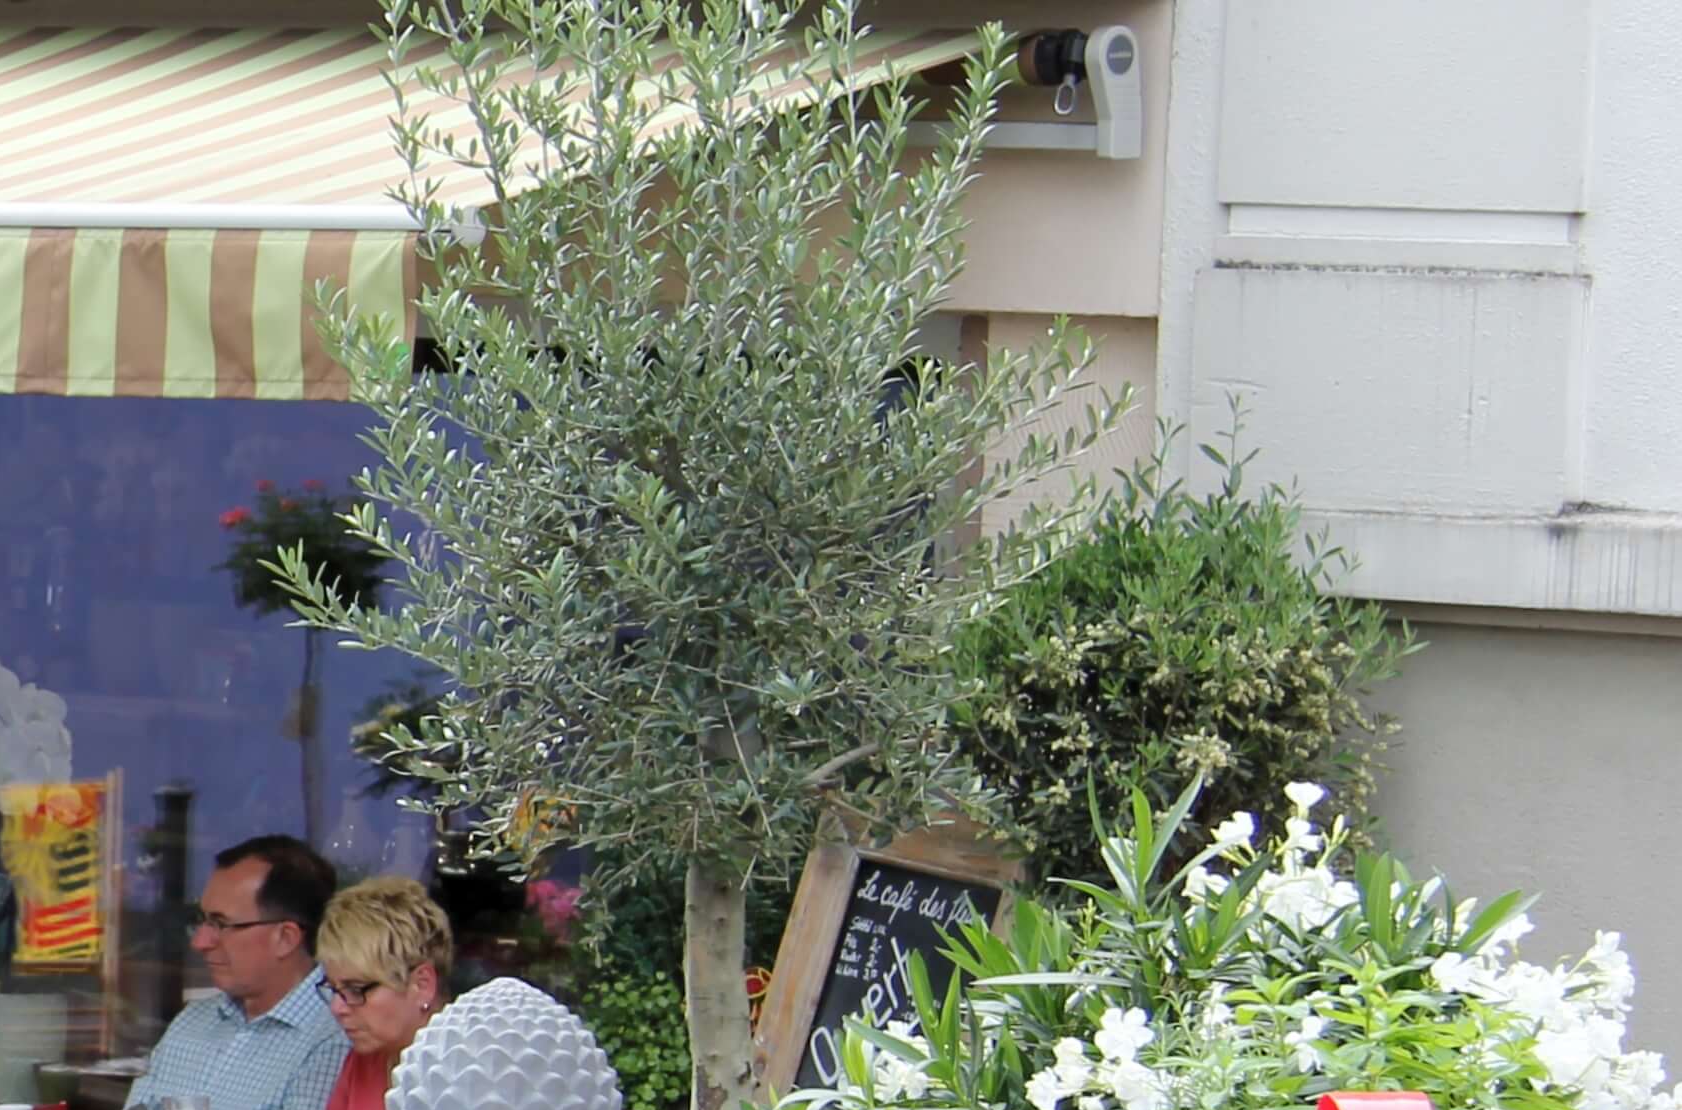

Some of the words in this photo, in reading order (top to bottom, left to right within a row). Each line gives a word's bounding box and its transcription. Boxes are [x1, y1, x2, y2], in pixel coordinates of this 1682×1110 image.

[857, 870, 880, 902] Le
[880, 880, 918, 925] café
[919, 886, 948, 920] des
